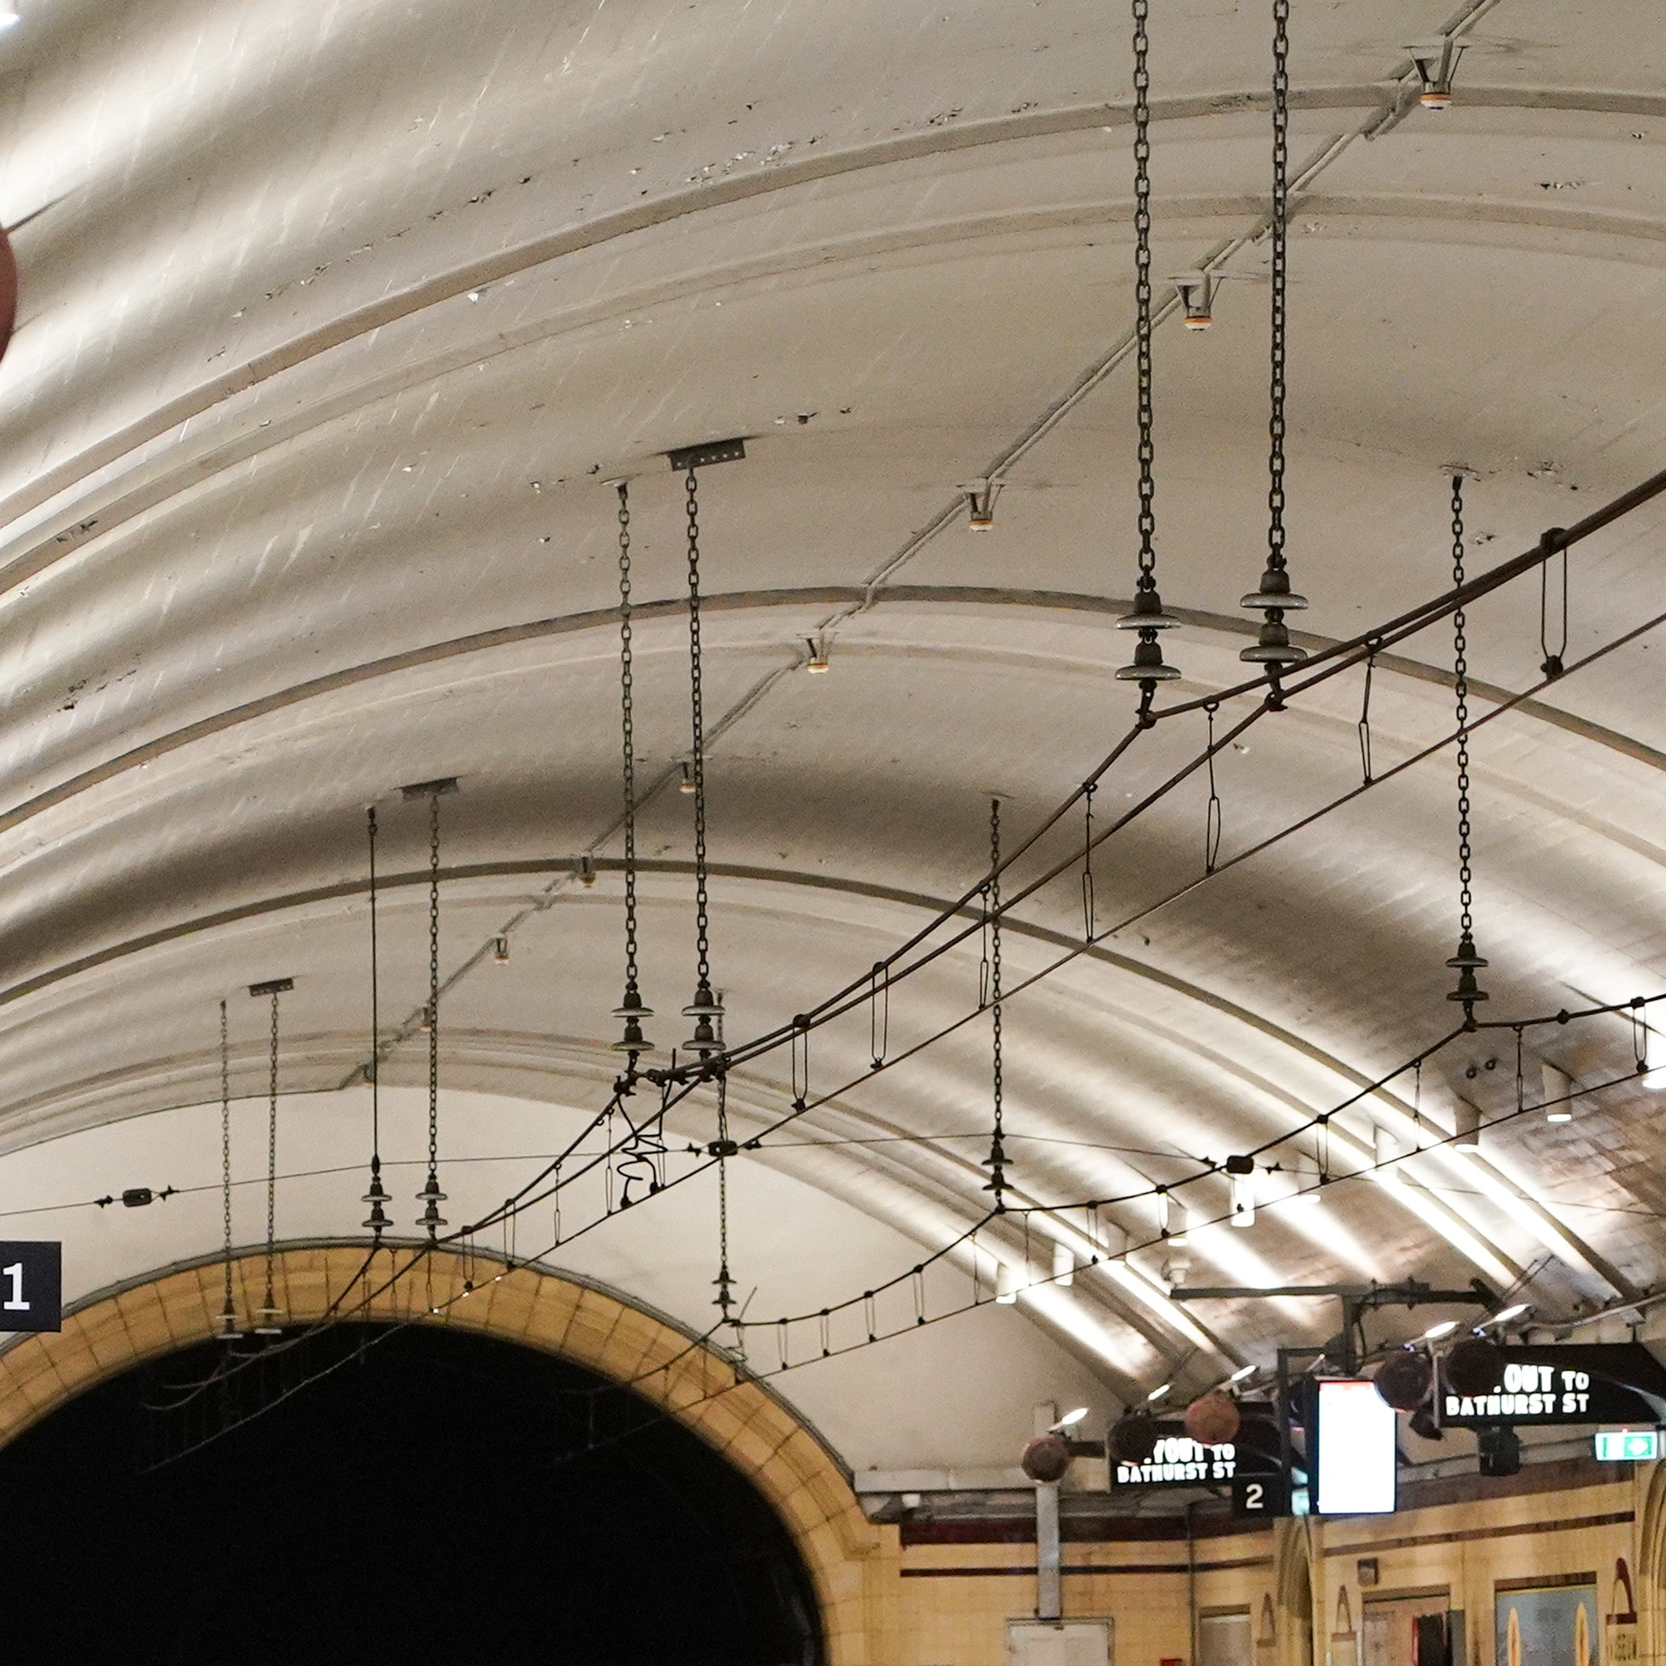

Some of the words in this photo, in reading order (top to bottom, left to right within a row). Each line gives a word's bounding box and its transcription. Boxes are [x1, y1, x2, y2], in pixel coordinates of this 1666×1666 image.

[2, 1262, 31, 1311] 1
[1561, 1370, 1590, 1391] TO
[1445, 1393, 1557, 1417] BATHURST
[1562, 1393, 1590, 1413] ST
[1210, 1443, 1236, 1461] TO
[1116, 1462, 1209, 1484] BATHURST
[1212, 1461, 1236, 1479] ST
[1245, 1483, 1264, 1509] 2
